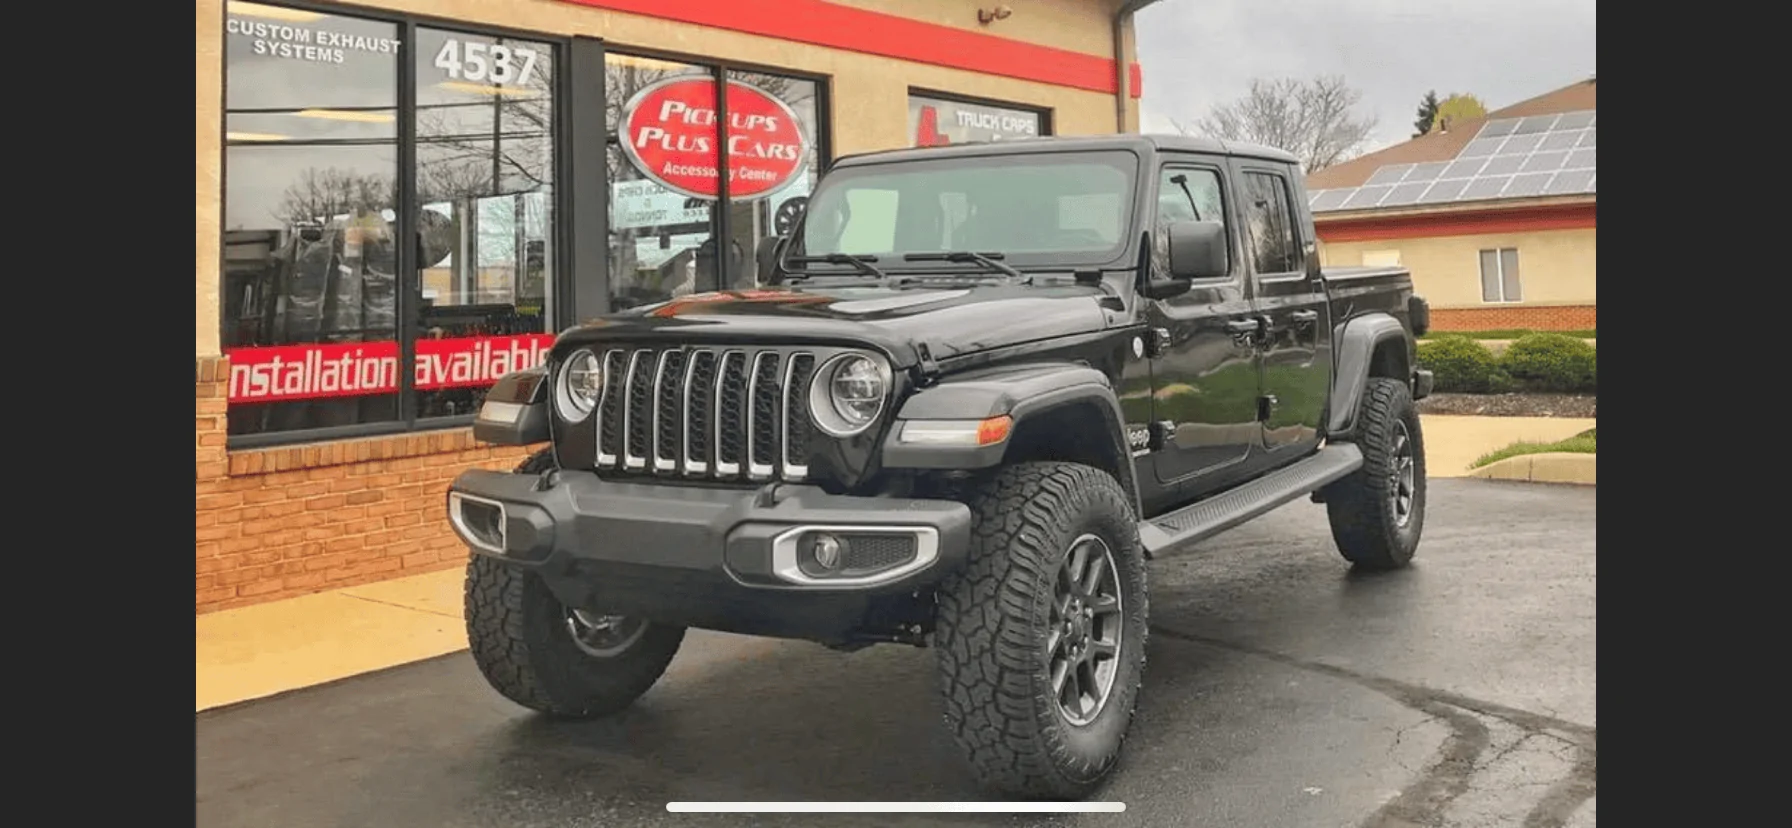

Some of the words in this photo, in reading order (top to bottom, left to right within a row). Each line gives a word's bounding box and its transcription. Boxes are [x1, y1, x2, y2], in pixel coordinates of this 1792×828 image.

[226, 19, 310, 43] CUSTOM
[316, 30, 402, 55] EXHAUST
[253, 40, 345, 64] SYSTEMS
[435, 39, 537, 86] 4537
[956, 110, 999, 130] TRUCK
[1002, 115, 1035, 135] CAPS
[636, 126, 711, 153] PLUS
[728, 134, 799, 161] CARS
[662, 161, 736, 181] Accessoy
[739, 166, 778, 182] Center
[227, 350, 397, 399] nstallation
